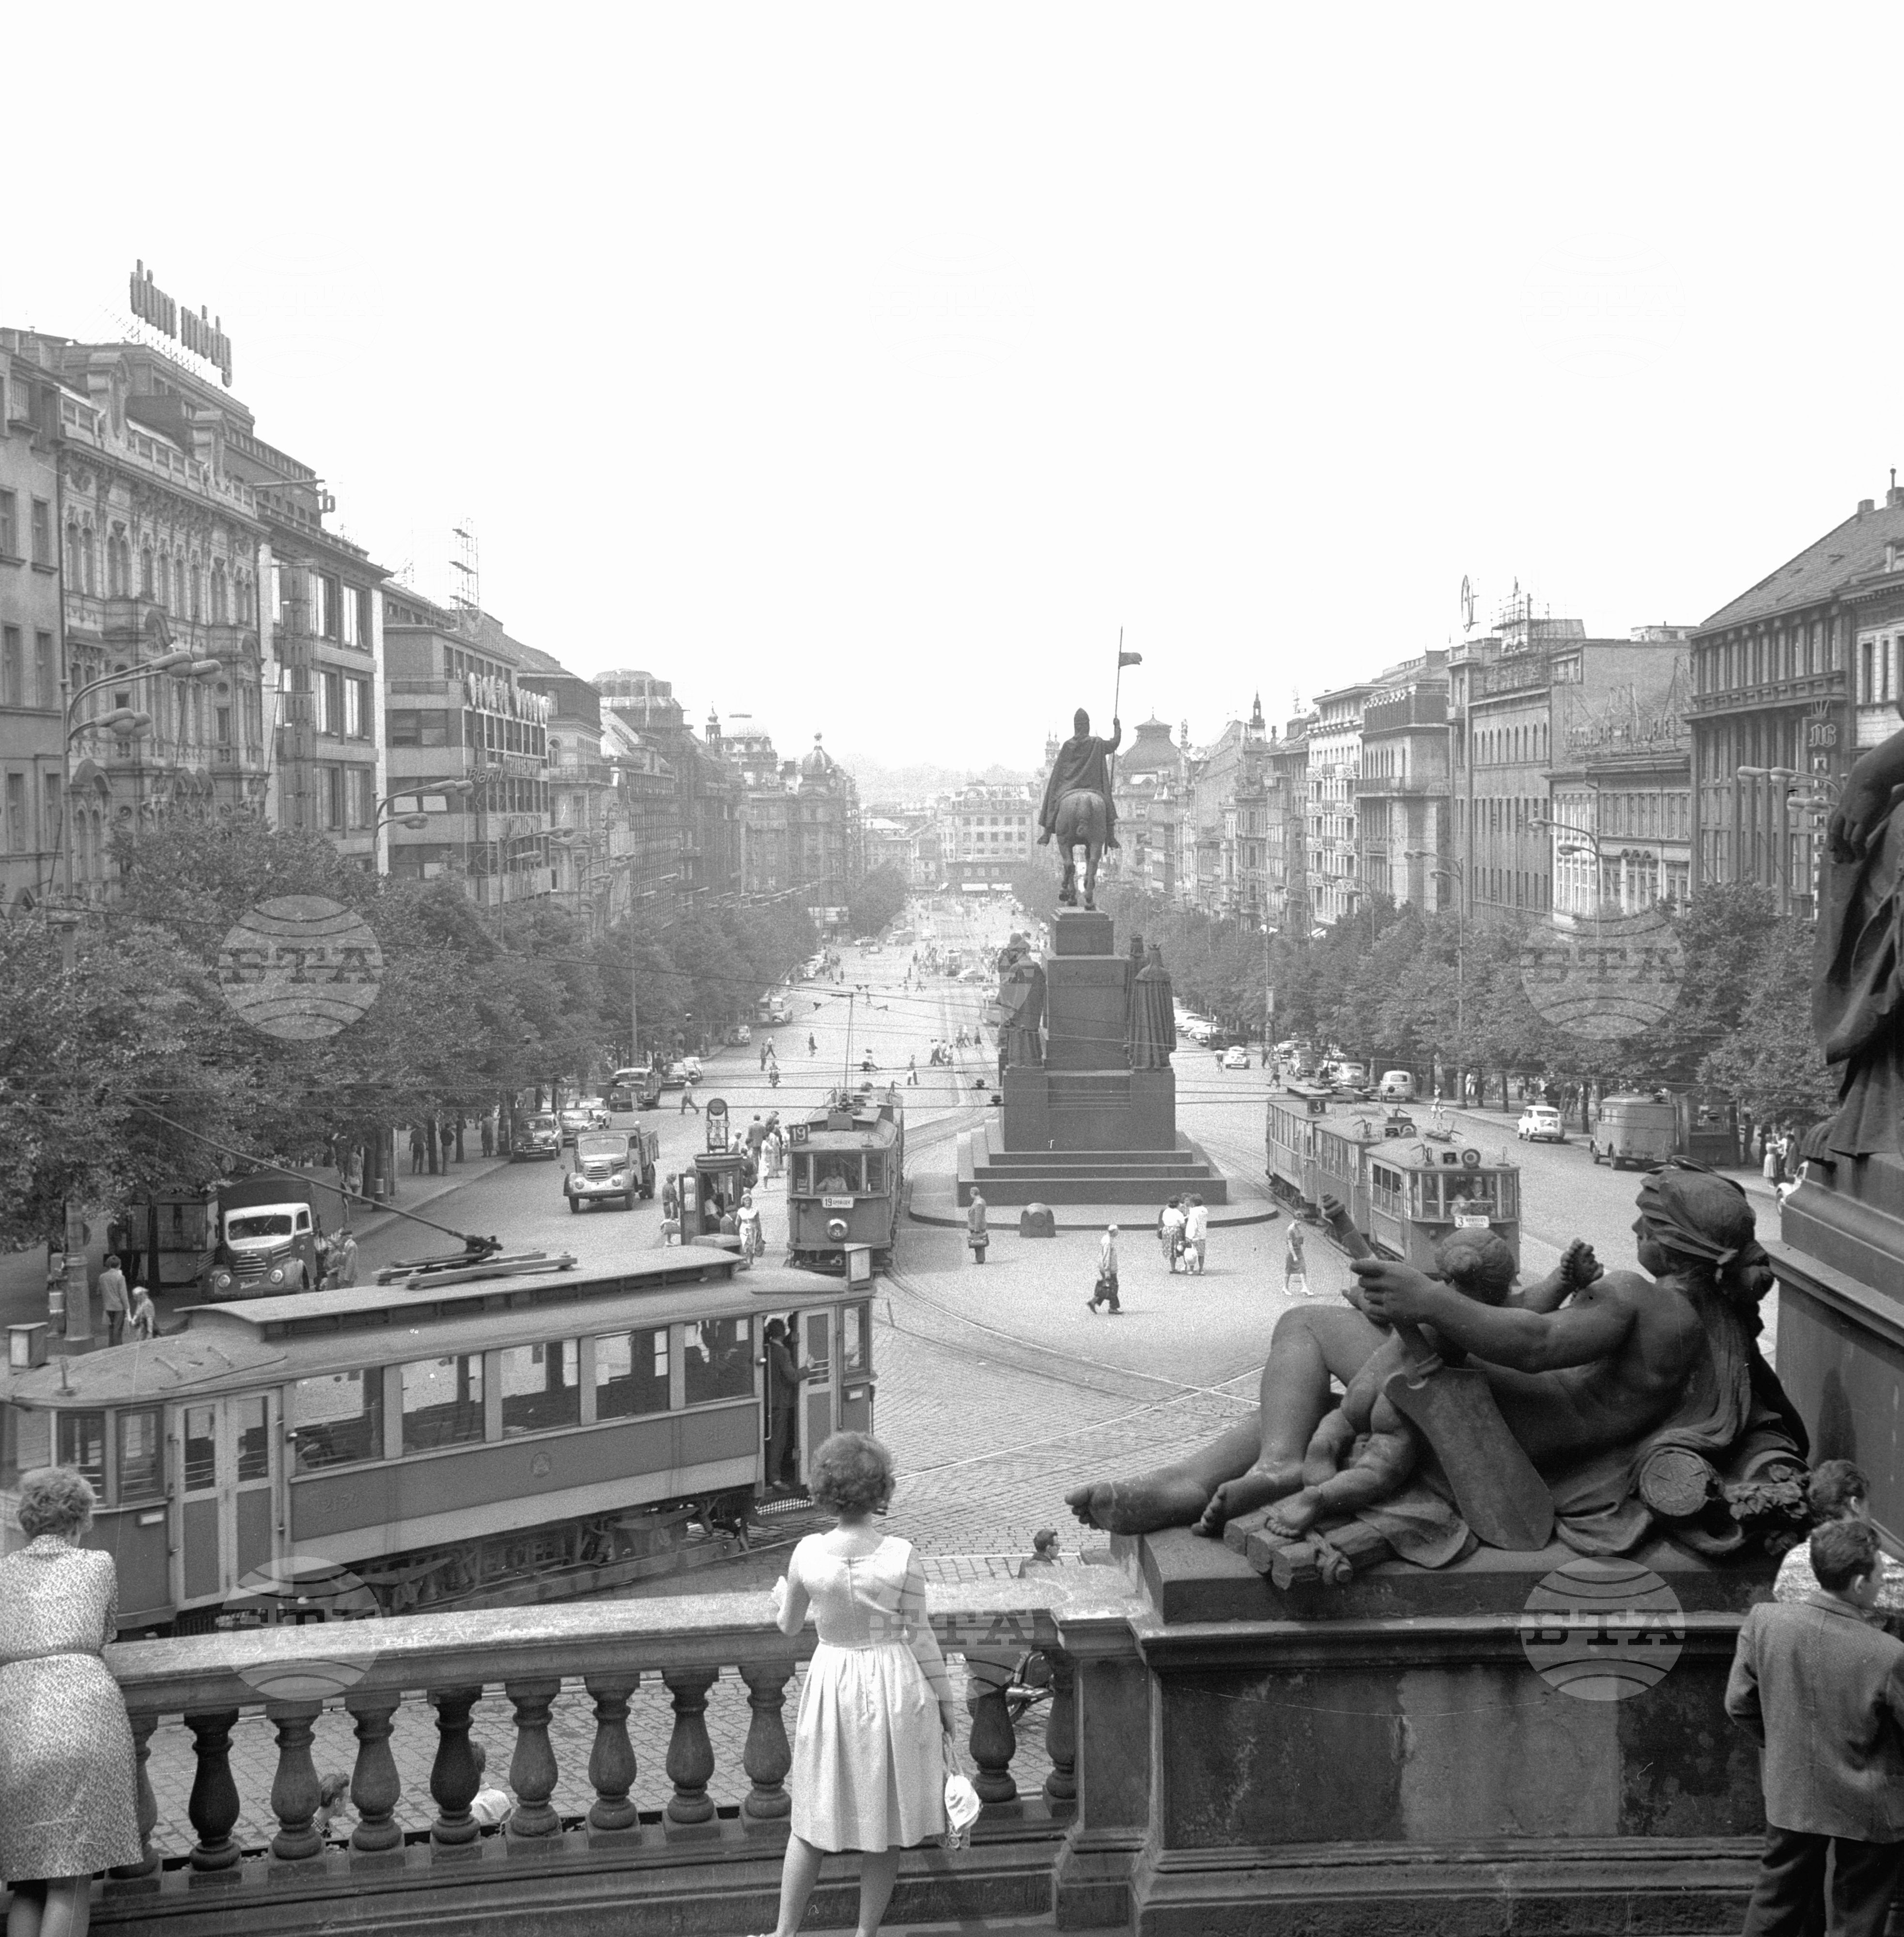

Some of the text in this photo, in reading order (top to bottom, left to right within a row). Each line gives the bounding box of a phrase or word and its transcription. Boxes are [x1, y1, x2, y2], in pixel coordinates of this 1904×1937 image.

[1314, 1101, 1321, 1112] 3
[792, 1126, 805, 1141] 19
[825, 1198, 832, 1206] 19
[1458, 1216, 1464, 1227] 3
